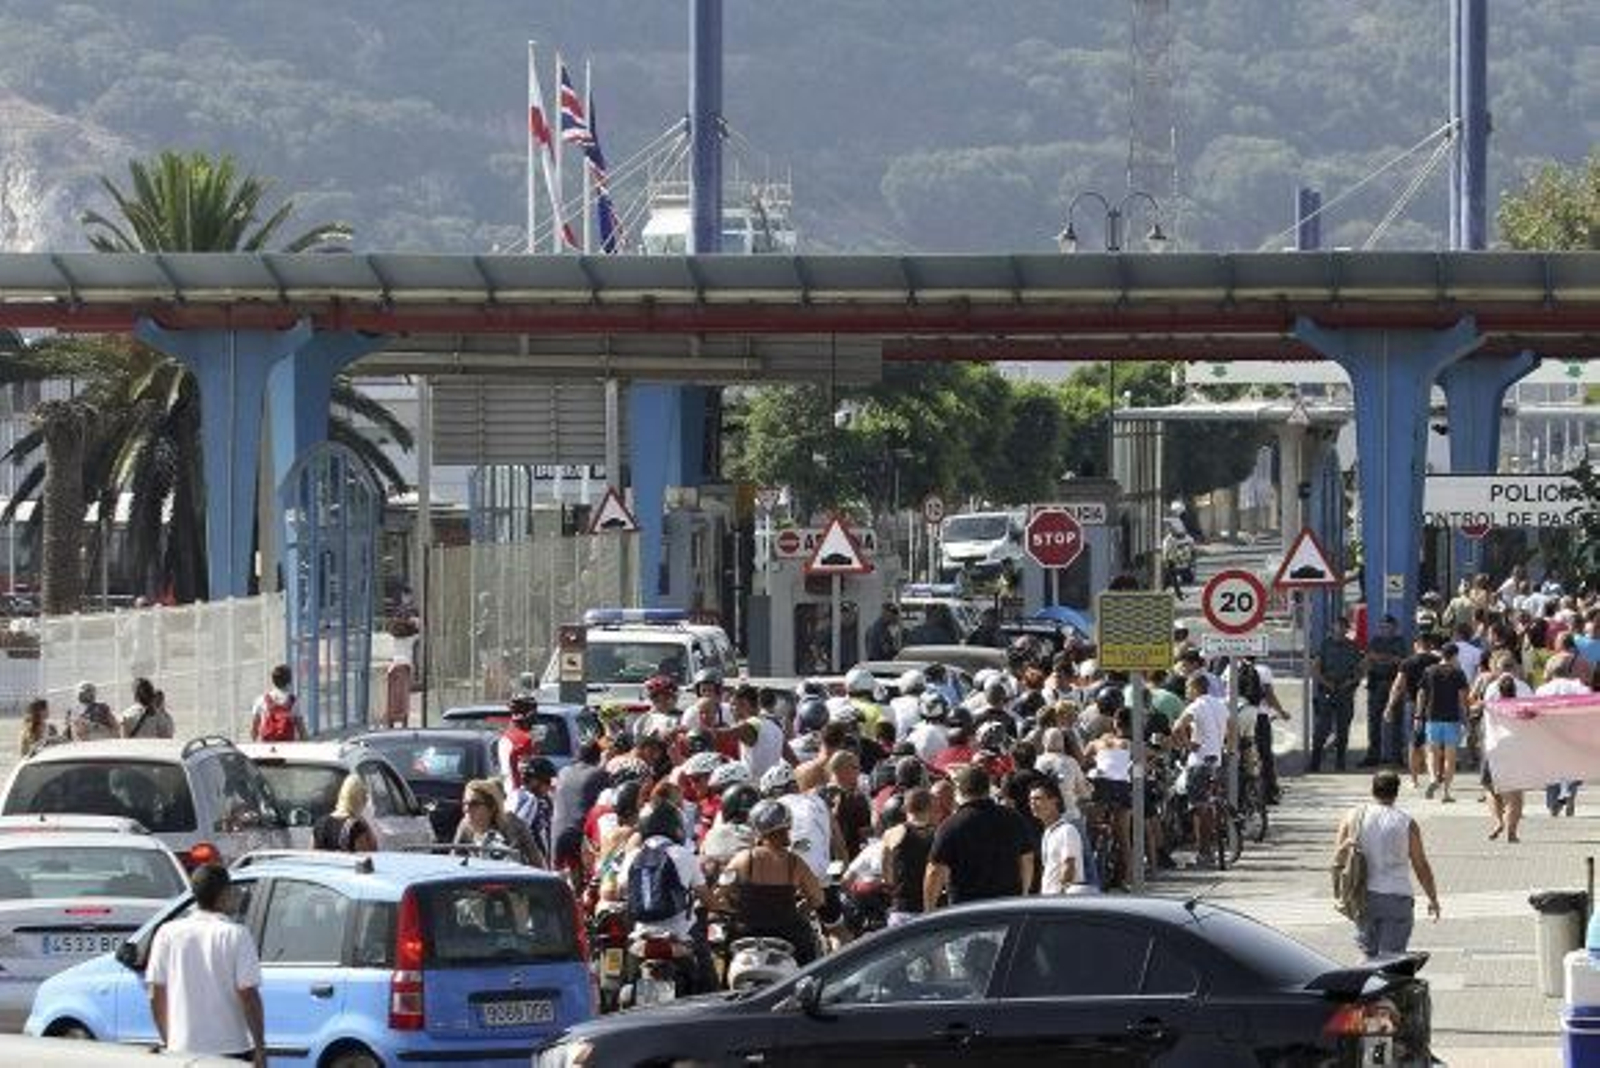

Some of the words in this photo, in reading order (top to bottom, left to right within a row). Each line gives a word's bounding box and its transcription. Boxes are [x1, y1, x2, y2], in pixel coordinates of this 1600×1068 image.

[1423, 511, 1500, 527] ONTROL
[1508, 511, 1532, 527] DE
[1033, 531, 1076, 546] STOP
[1220, 591, 1254, 612] 20
